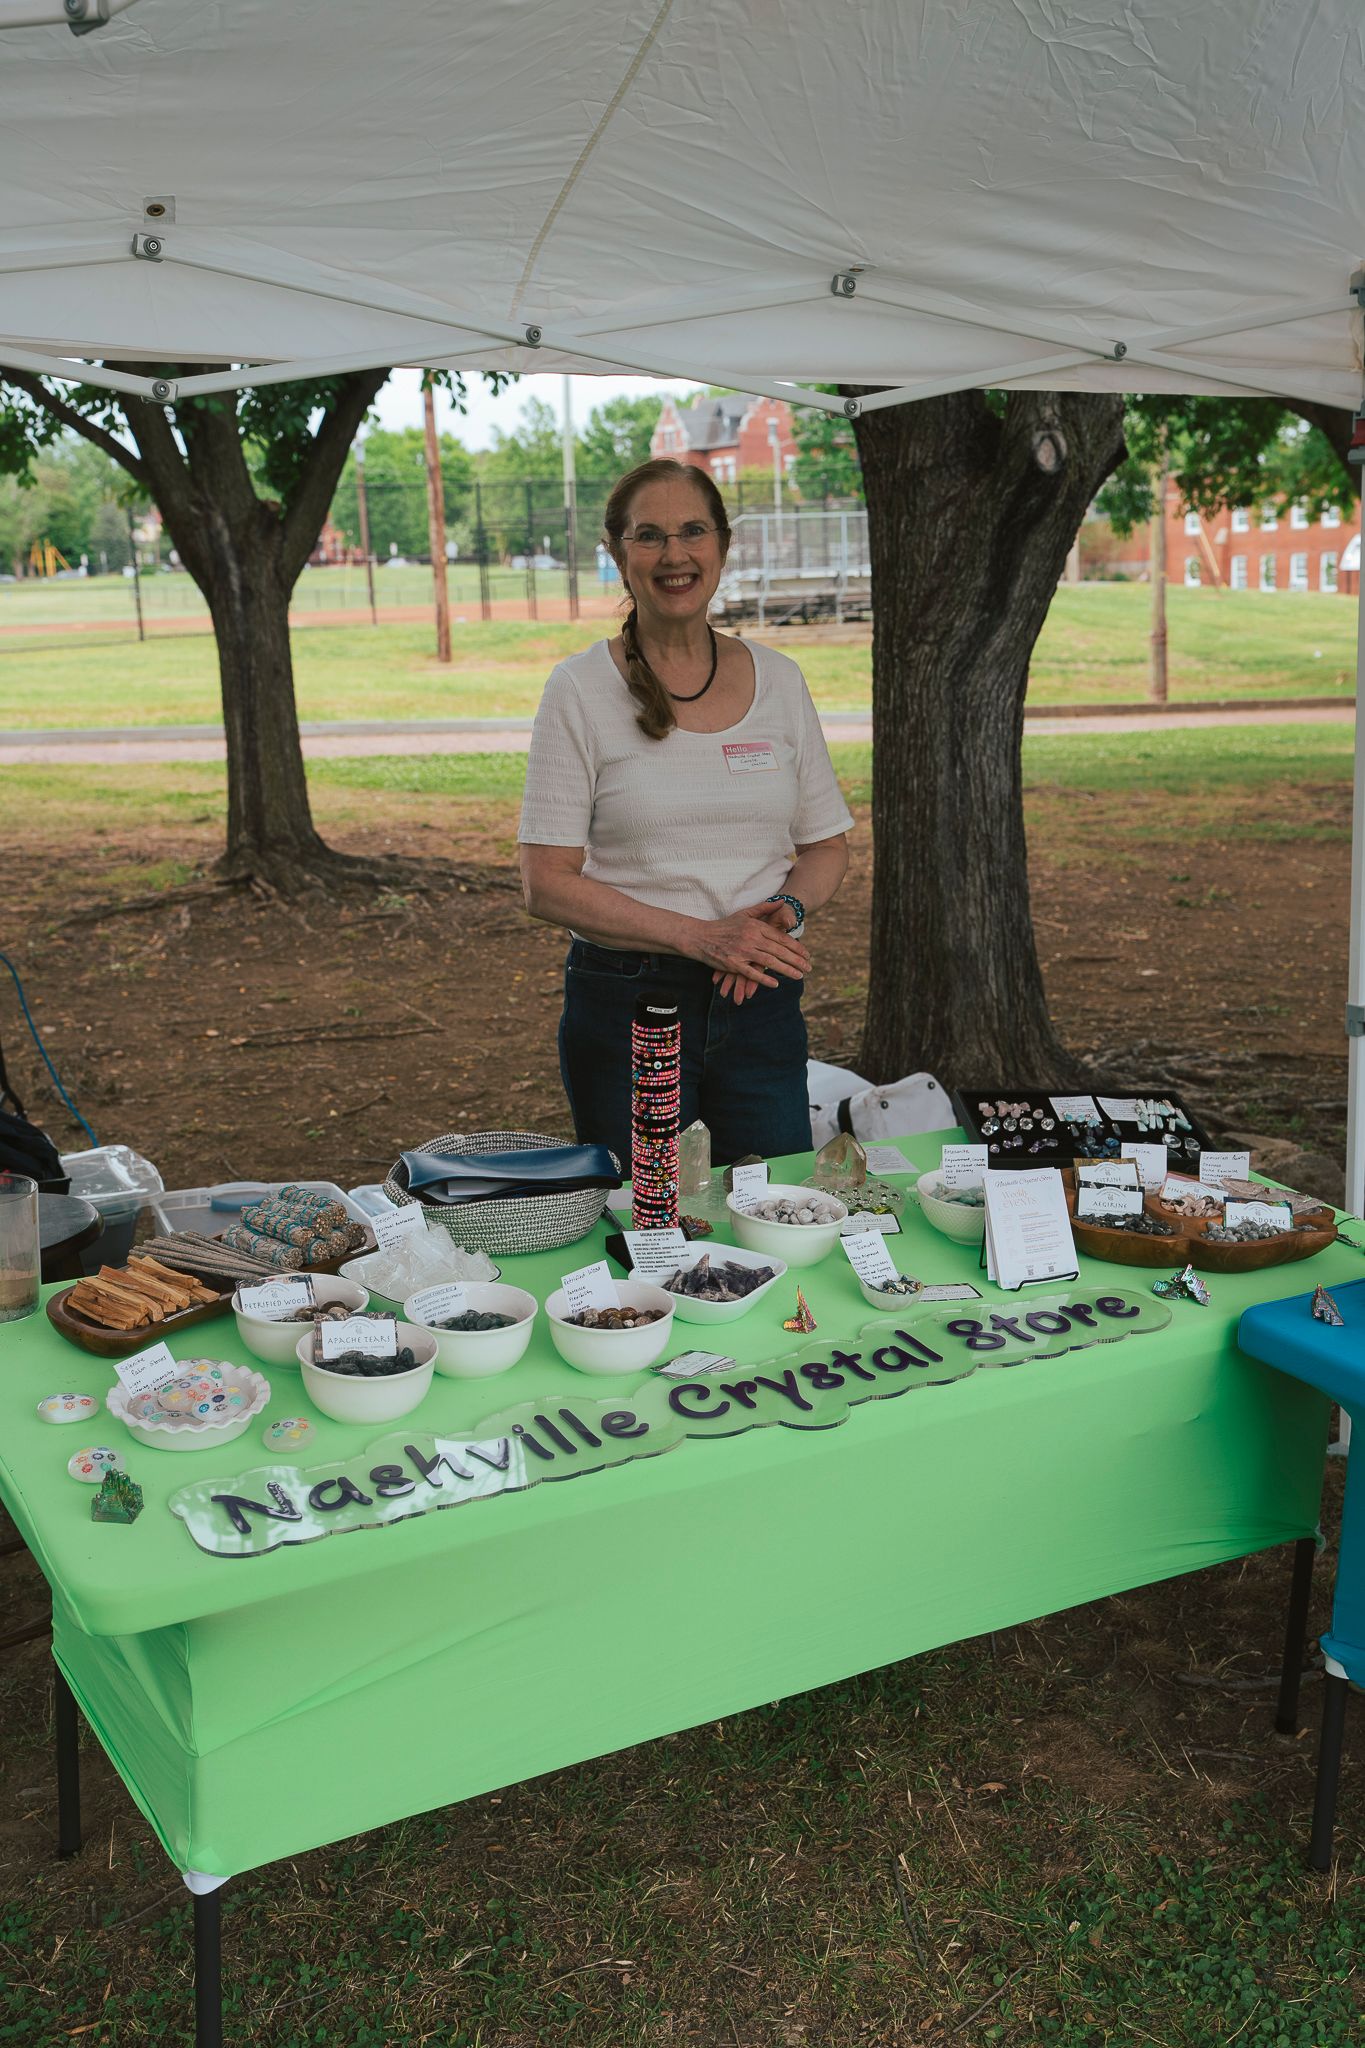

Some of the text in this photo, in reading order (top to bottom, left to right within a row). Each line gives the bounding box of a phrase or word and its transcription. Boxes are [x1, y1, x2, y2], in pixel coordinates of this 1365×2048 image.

[725, 745, 748, 754] Hello
[1092, 1200, 1128, 1209] AEGIRINE
[1229, 1214, 1286, 1226] LABRADORITE
[244, 1297, 307, 1310] PETRIFIED WOOD
[327, 1335, 391, 1345] APACHE TEARS
[211, 1296, 1140, 1534] Nashville Crystal Store
